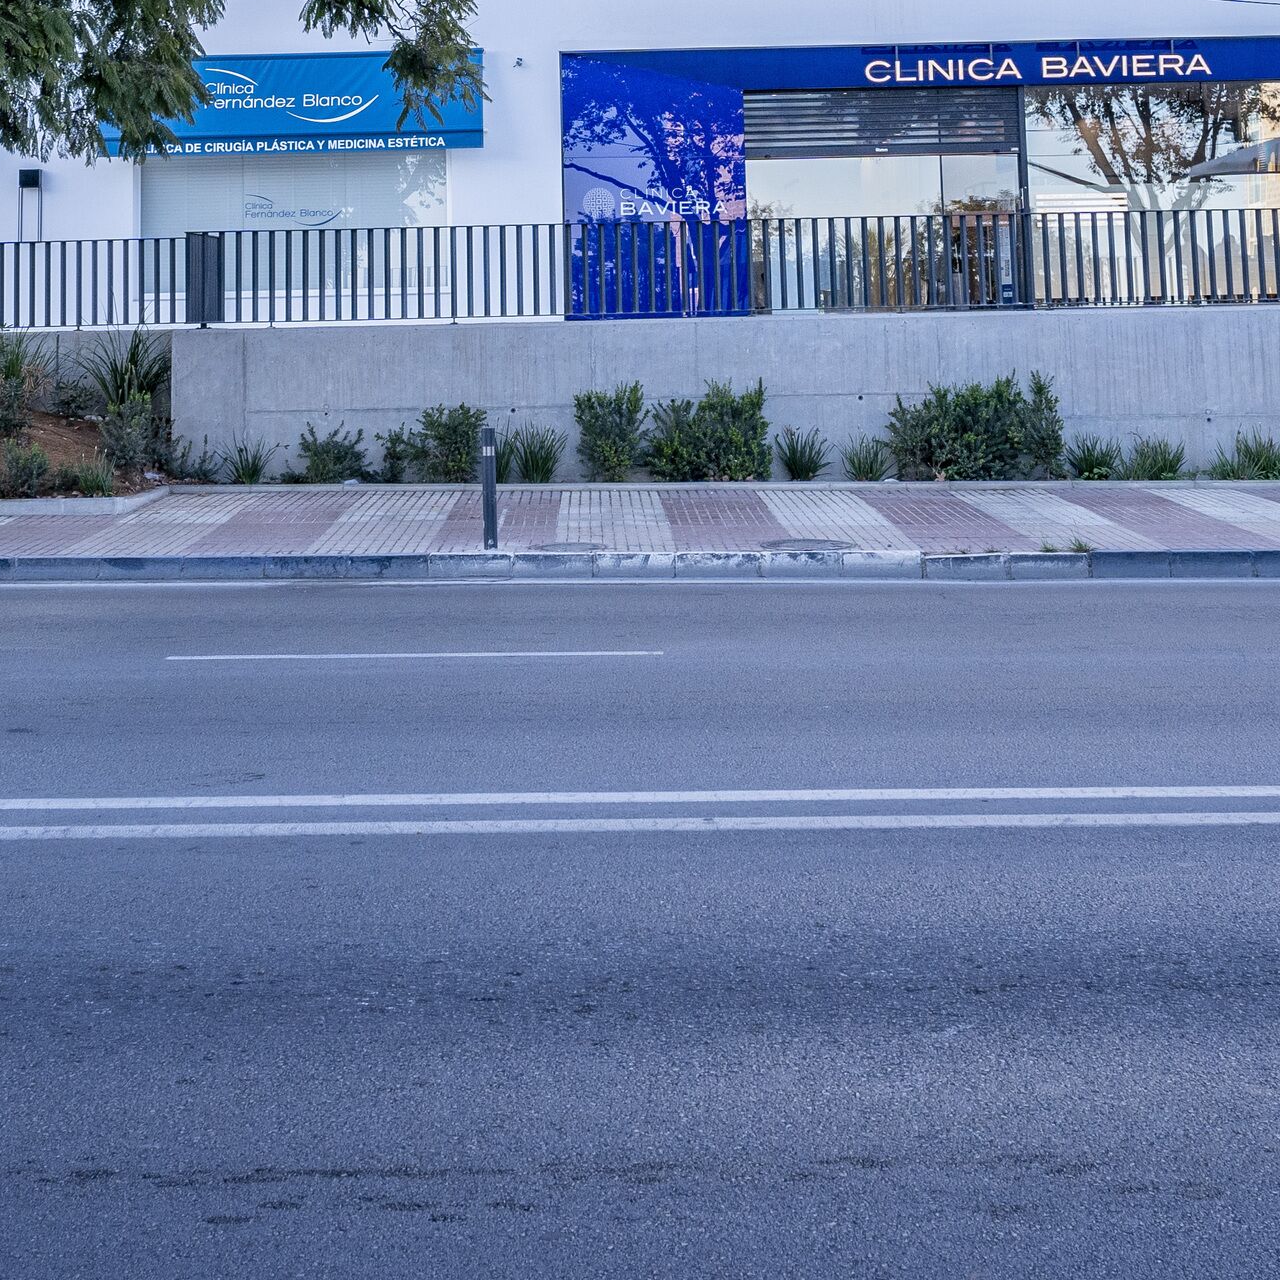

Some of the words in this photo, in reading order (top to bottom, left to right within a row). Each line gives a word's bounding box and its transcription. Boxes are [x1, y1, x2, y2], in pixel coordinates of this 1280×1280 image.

[864, 57, 1022, 83] CLINICA
[1040, 53, 1212, 78] BAVIERA
[205, 82, 254, 95] Clínica
[302, 93, 363, 107] Blanco
[185, 142, 202, 153] DE
[204, 140, 254, 153] CIRUGÍA
[256, 138, 315, 151] PLÁSTICA
[316, 140, 326, 150] Y
[327, 138, 386, 150] MEDICINA
[387, 135, 446, 148] ESTÉTICA
[619, 187, 696, 200] CLINICA
[244, 209, 296, 218] Fernández
[299, 208, 334, 217] Blanco
[620, 200, 729, 216] BAVIERA
